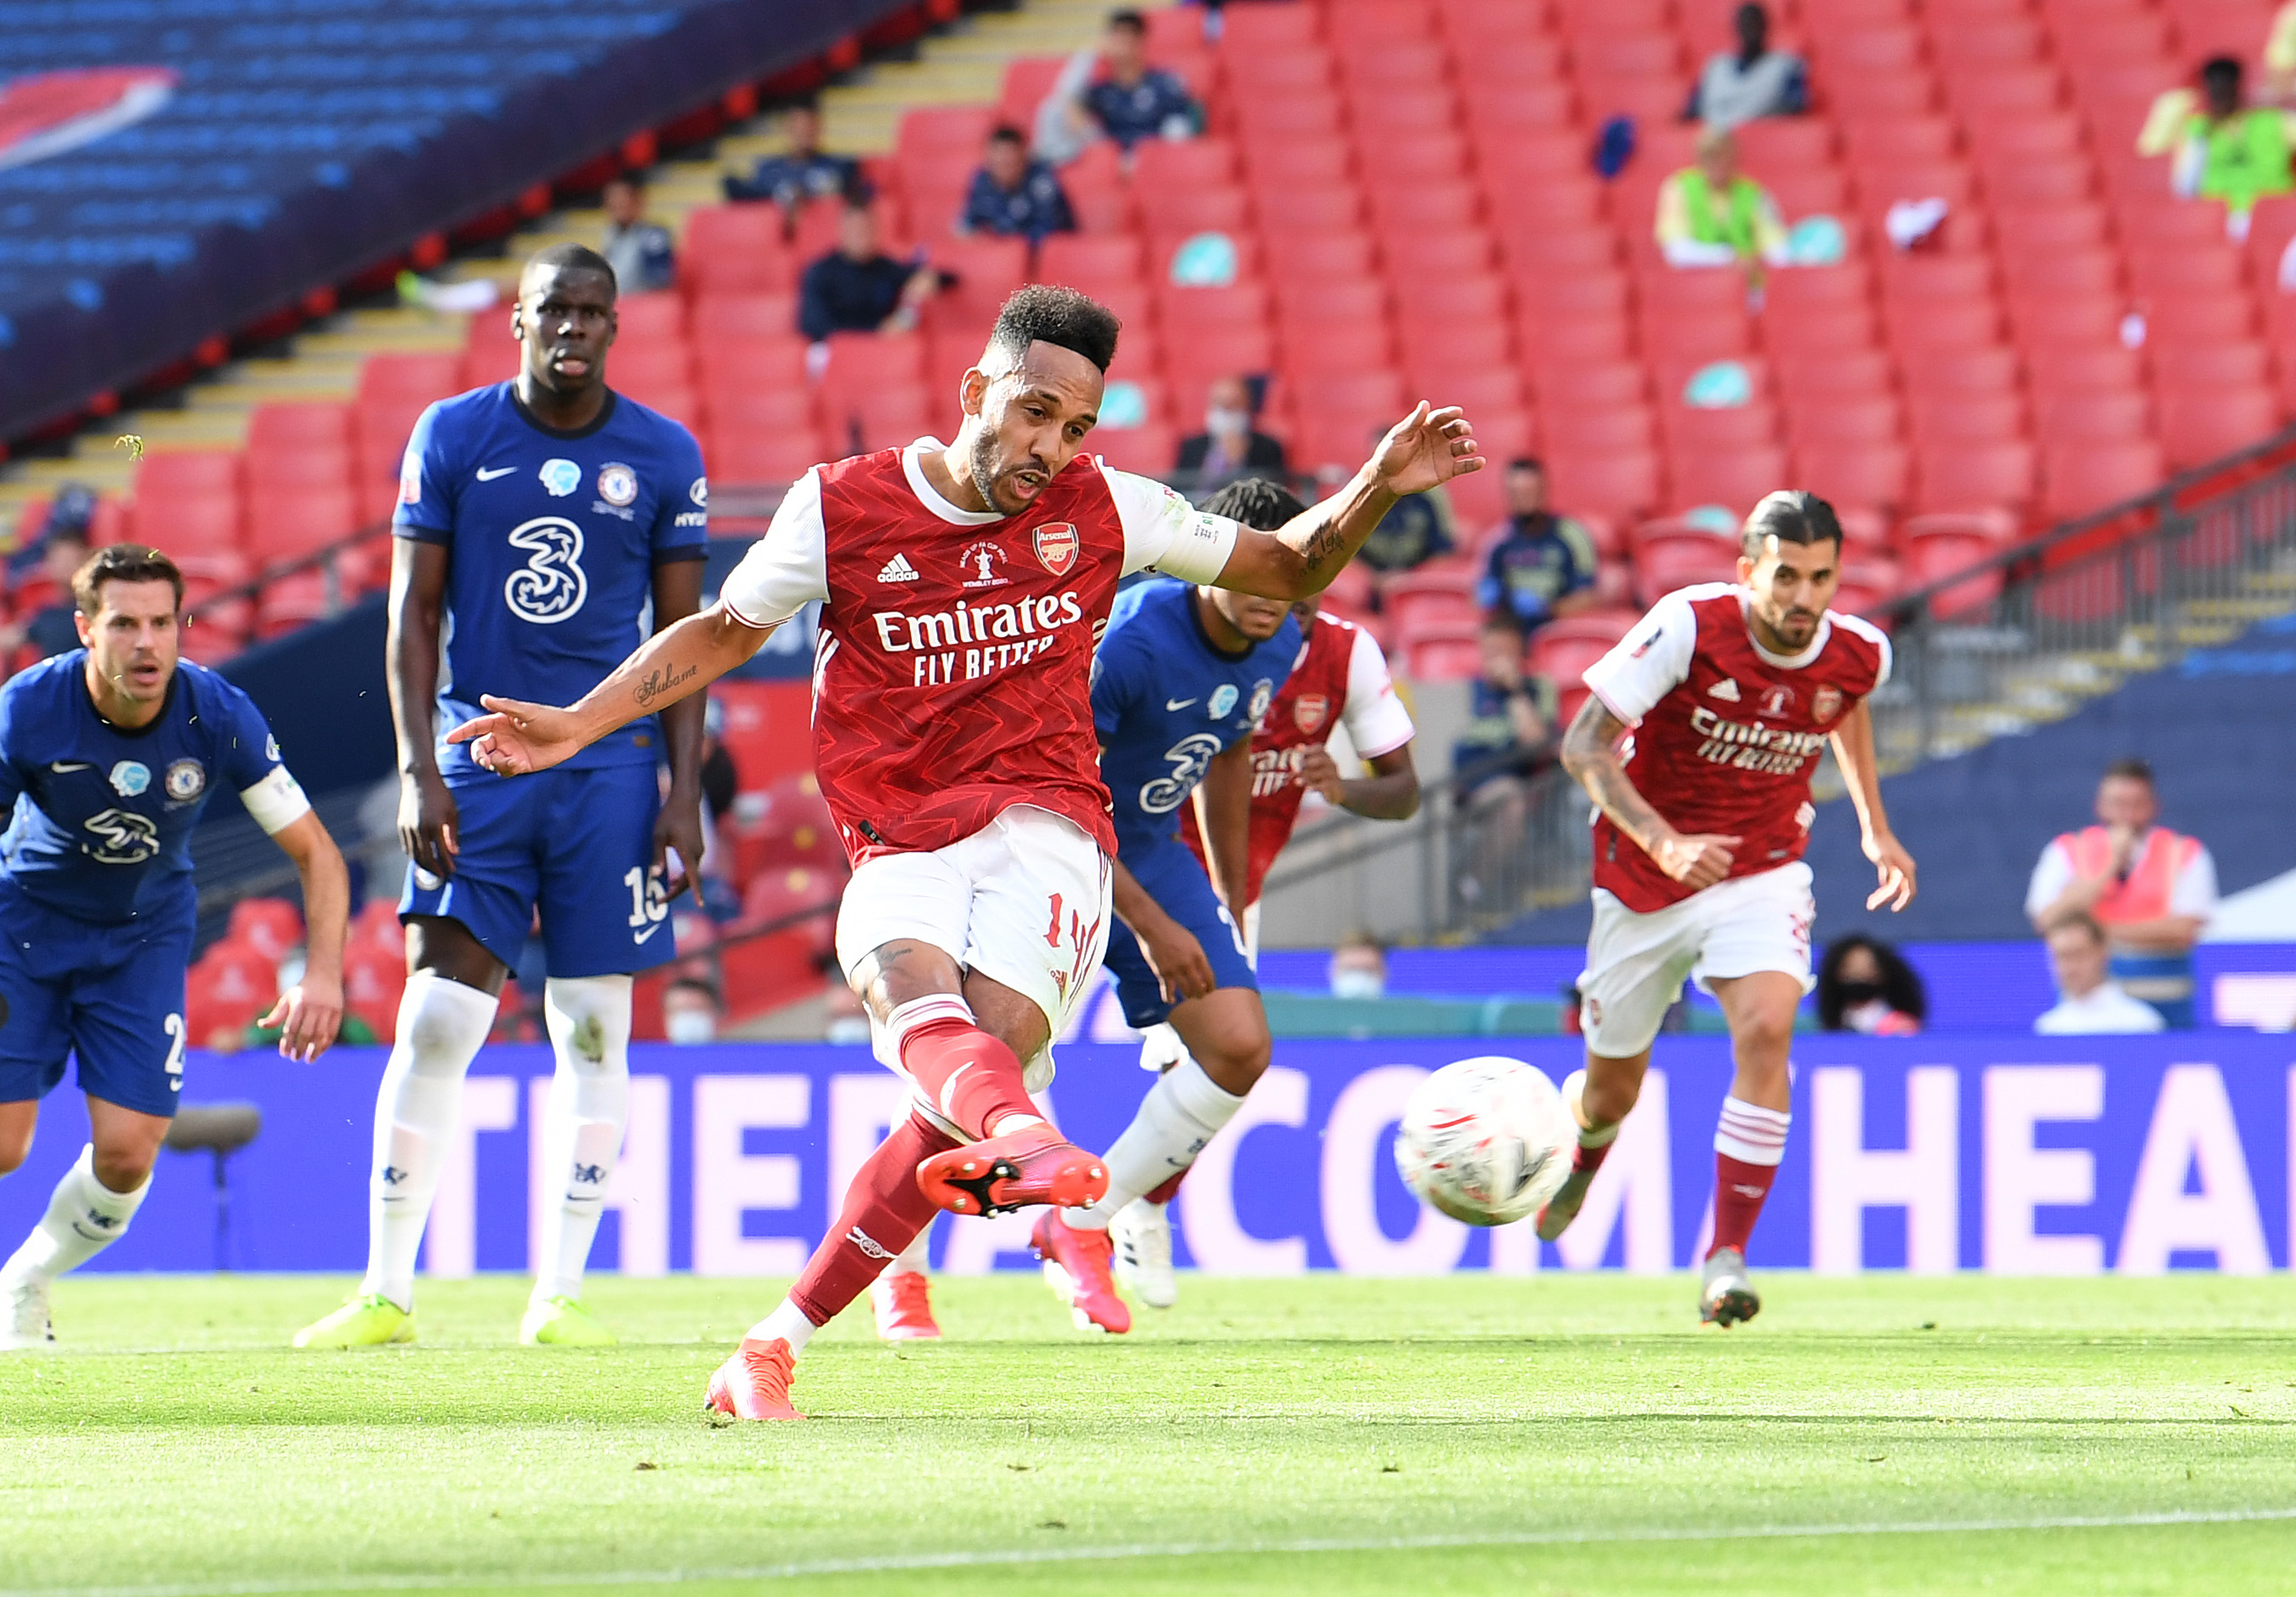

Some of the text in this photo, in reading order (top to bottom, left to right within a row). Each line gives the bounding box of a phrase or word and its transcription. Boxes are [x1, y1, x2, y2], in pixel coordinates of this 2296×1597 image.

[1039, 529, 1071, 542] Arsenal
[505, 516, 588, 624] 3
[877, 570, 920, 583] adidas
[872, 591, 1083, 652] Emirates
[914, 634, 1054, 687] FLY BETTER
[623, 866, 669, 928] 15
[1811, 1063, 2296, 1277] HEA
